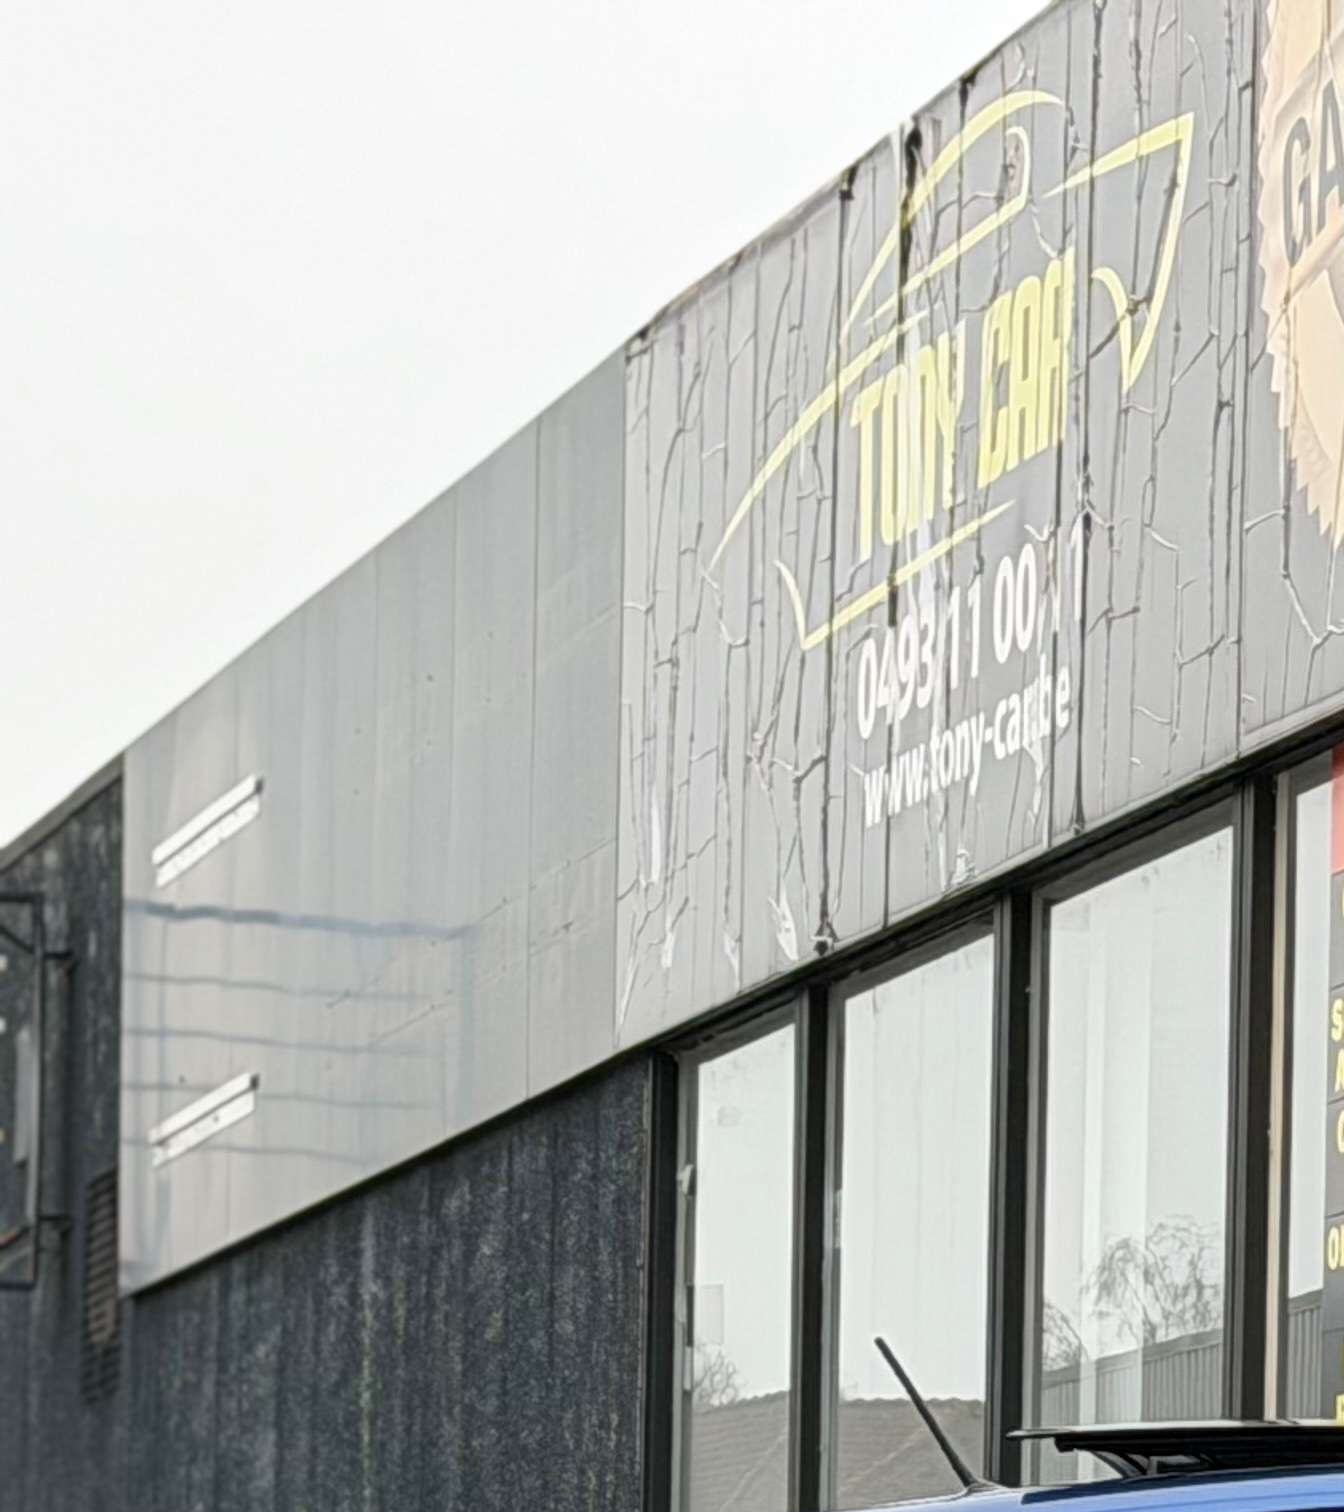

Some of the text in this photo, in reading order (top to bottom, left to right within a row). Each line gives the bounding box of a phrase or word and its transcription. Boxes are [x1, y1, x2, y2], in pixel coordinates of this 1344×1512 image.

[850, 245, 1076, 561] TONY CAR
[992, 542, 1038, 665] 00
[863, 652, 1071, 830] www.tony-car.be
